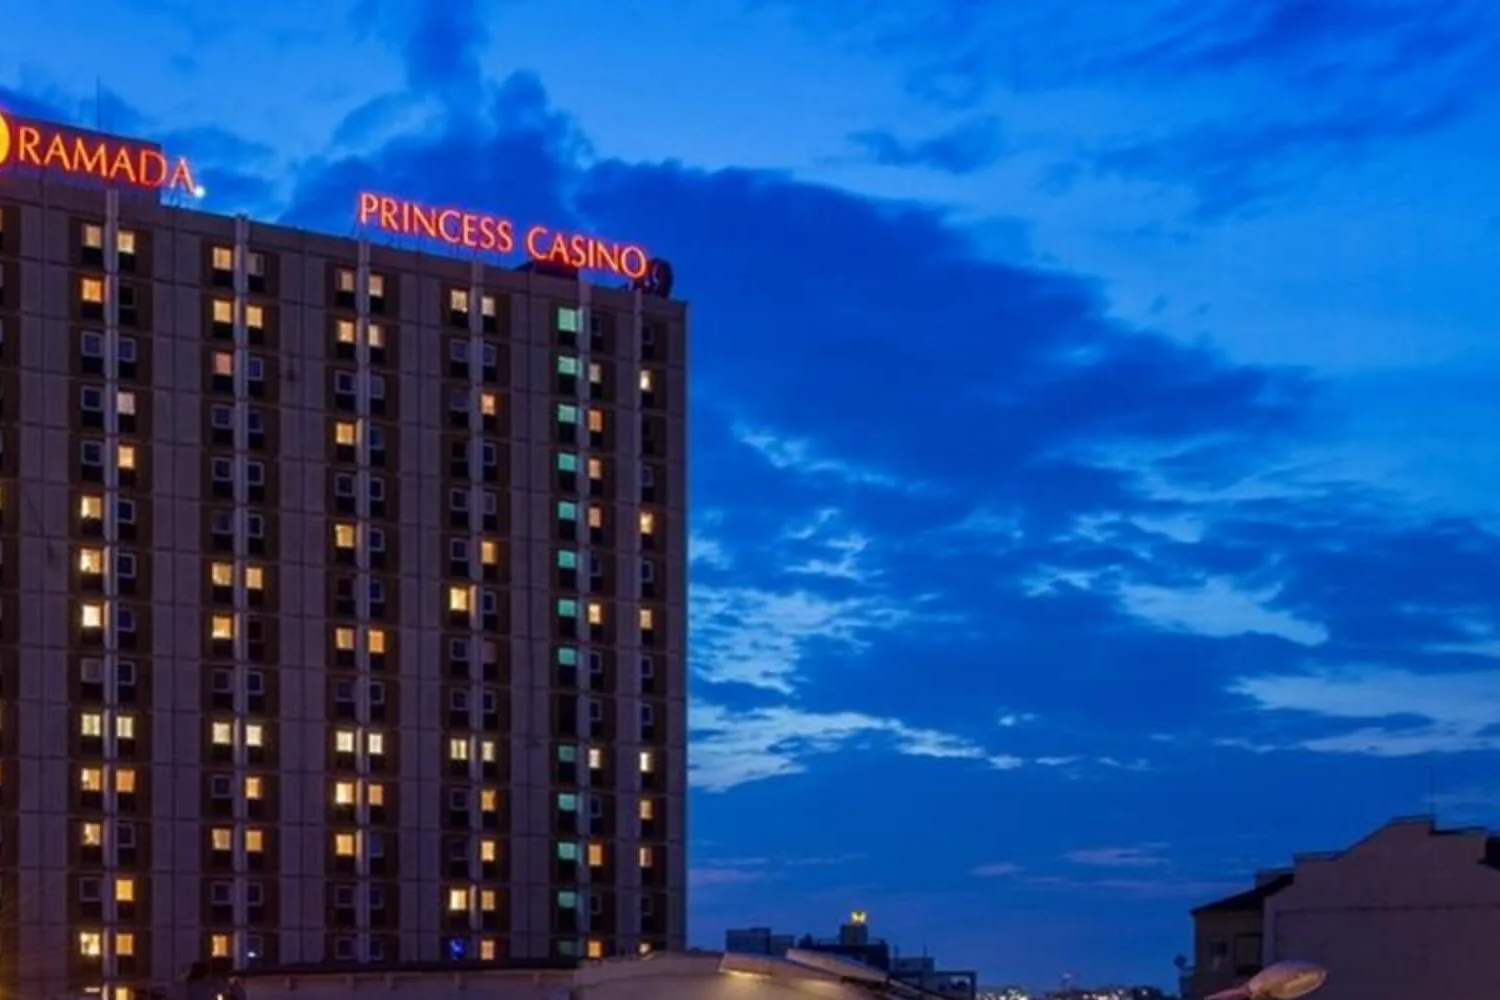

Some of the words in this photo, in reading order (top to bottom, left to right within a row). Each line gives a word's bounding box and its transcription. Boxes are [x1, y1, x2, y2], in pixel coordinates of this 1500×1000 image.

[18, 125, 197, 194] RAMADA
[357, 192, 515, 252] PRINCESS
[526, 226, 648, 279] CASINO
